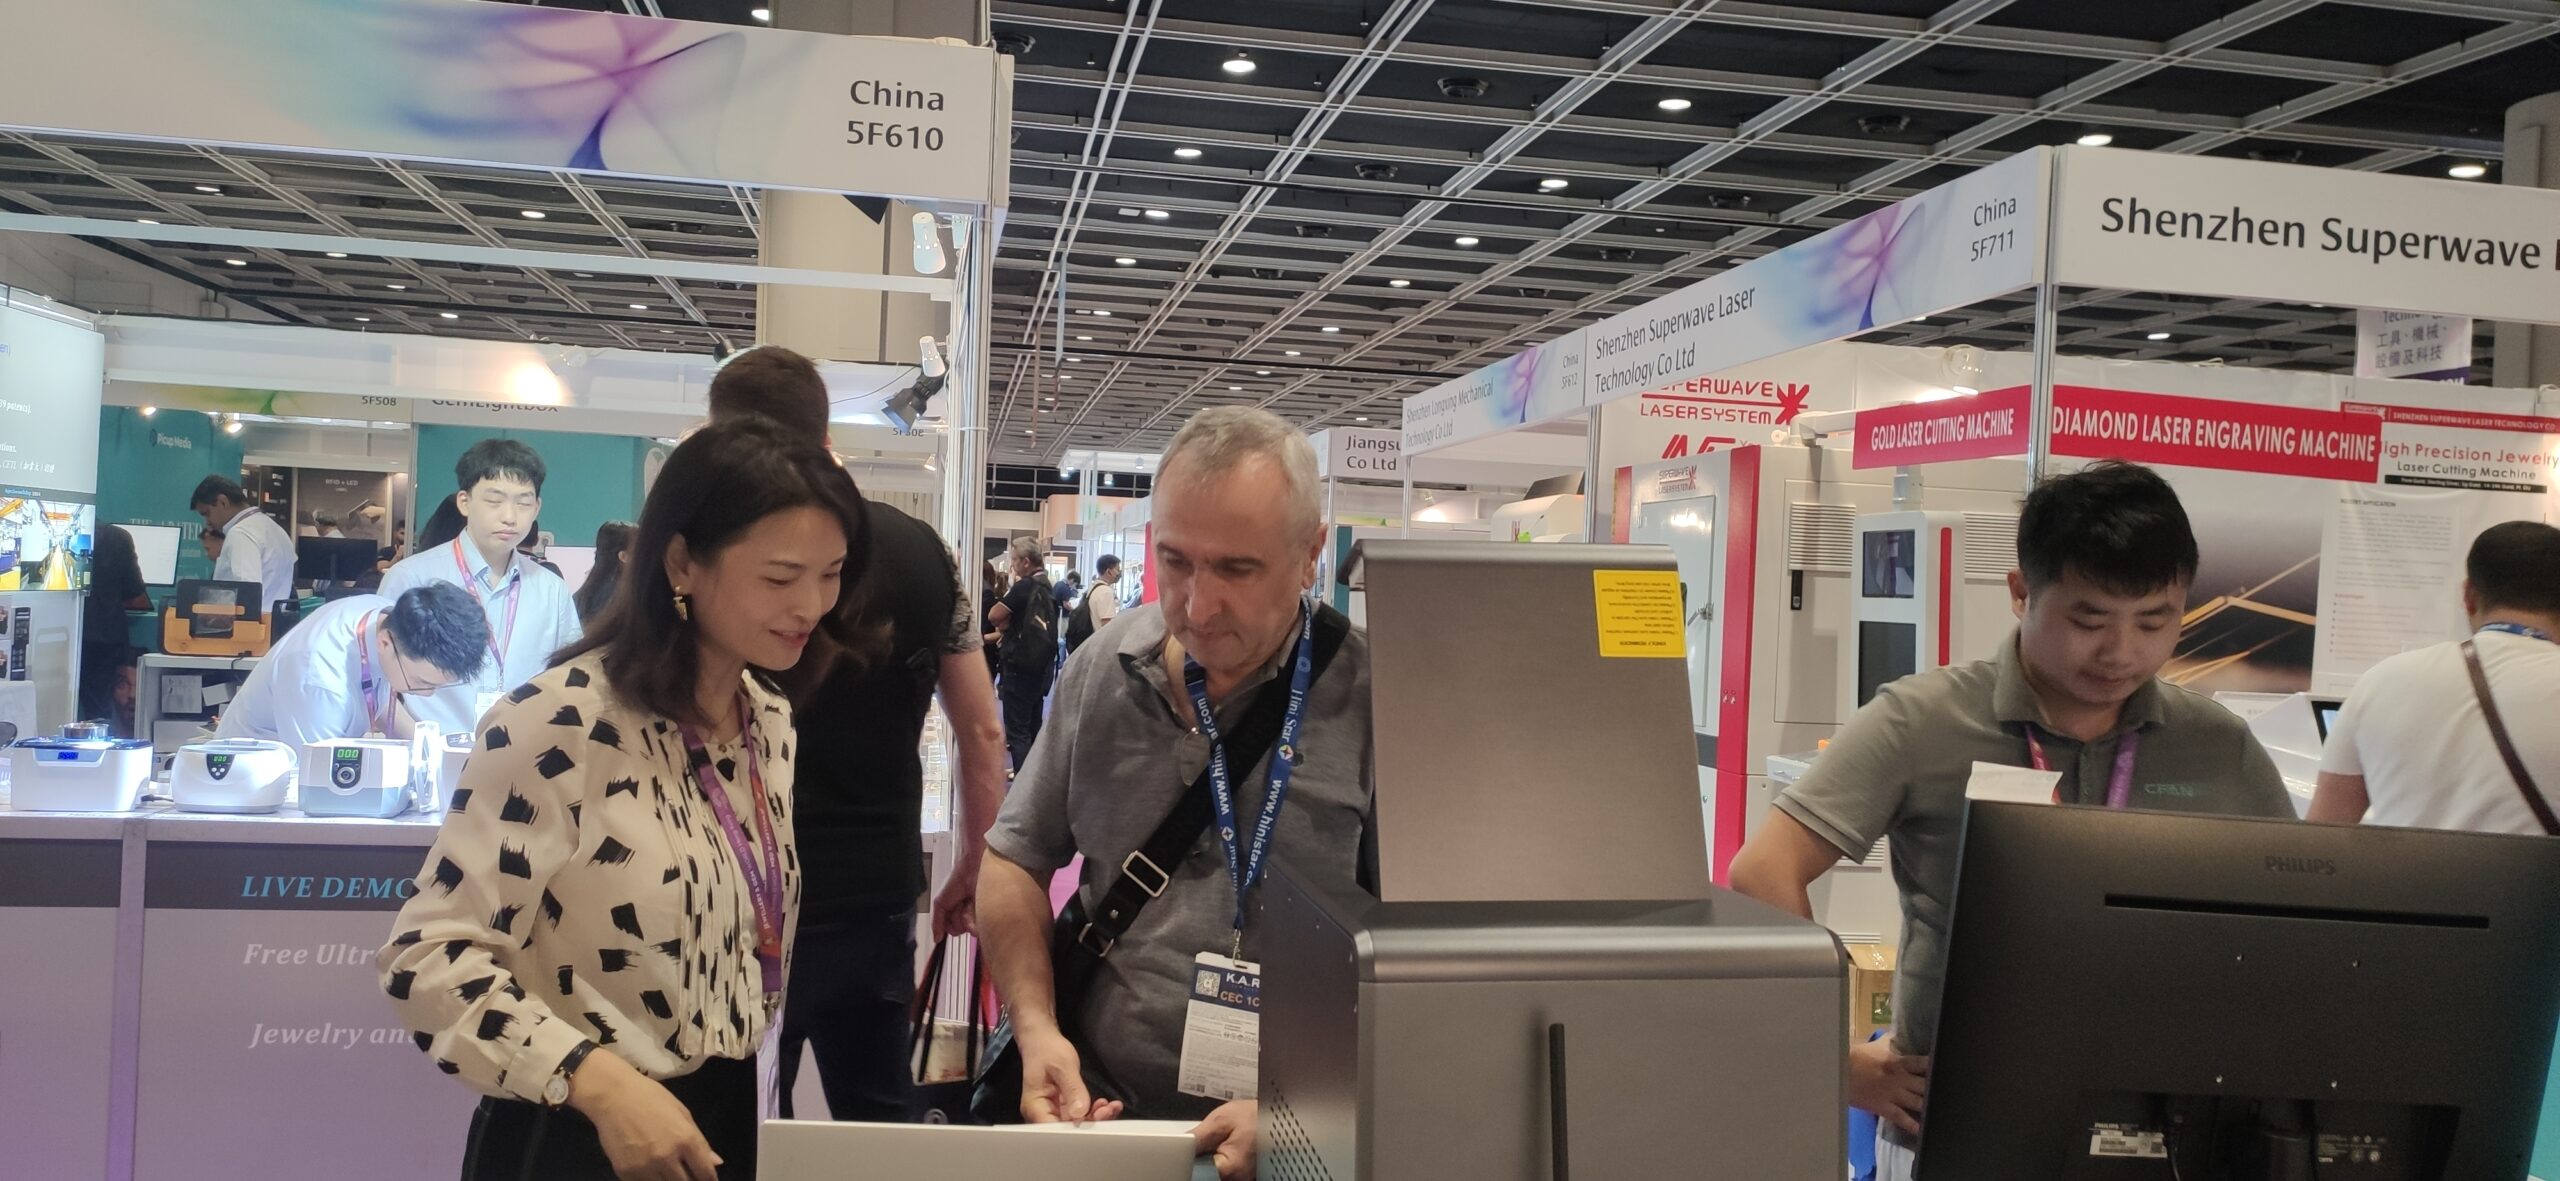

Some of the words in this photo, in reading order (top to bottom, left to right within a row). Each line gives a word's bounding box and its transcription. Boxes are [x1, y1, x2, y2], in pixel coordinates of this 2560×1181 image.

[850, 80, 944, 111] China
[847, 120, 944, 151] 5F610
[1973, 196, 2016, 227] China
[1970, 229, 2014, 262] 5F711
[2100, 197, 2305, 249] Shenzhen
[2320, 217, 2541, 270] Superwave
[1596, 325, 1646, 360] Shenzhen
[1649, 300, 1715, 343] Superwave
[1719, 287, 1756, 317] Laser
[1562, 354, 1579, 369] China
[1595, 358, 1653, 394] Technology
[1657, 353, 1672, 376] Co
[1675, 342, 1696, 372] Ltd
[361, 396, 397, 406] 5F508
[1406, 404, 1431, 424] Shenzhen
[1458, 377, 1494, 405] Mechanical
[1406, 427, 1434, 448] Technology
[1435, 423, 1443, 440] Co
[1443, 418, 1453, 438] Ltd
[1871, 425, 1897, 451] GOLD
[1897, 421, 1924, 448] LASER
[1924, 415, 1965, 446] CUTTING
[1966, 408, 2015, 441] MACHINE
[2052, 406, 2138, 441] DIAMOND
[2142, 414, 2190, 445] LASER
[2195, 420, 2296, 455] ENGRAVING
[2298, 429, 2376, 463] MACHINE
[1346, 455, 1367, 470] Co
[1372, 456, 1397, 471] Ltd
[2381, 442, 2409, 458] igh
[2416, 443, 2491, 462] Precision
[2496, 449, 2559, 469] Jewelry
[2397, 461, 2429, 473] Laser
[2433, 463, 2477, 479] Cutting
[2480, 467, 2536, 480] Machine
[1287, 688, 1303, 714] Hini
[1281, 718, 1297, 743] Star
[2265, 855, 2336, 876] PHILIPS
[241, 876, 315, 898] LIVE
[243, 943, 308, 965] Free
[1220, 990, 1244, 1004] CEC
[248, 1022, 364, 1049] Jewelry
